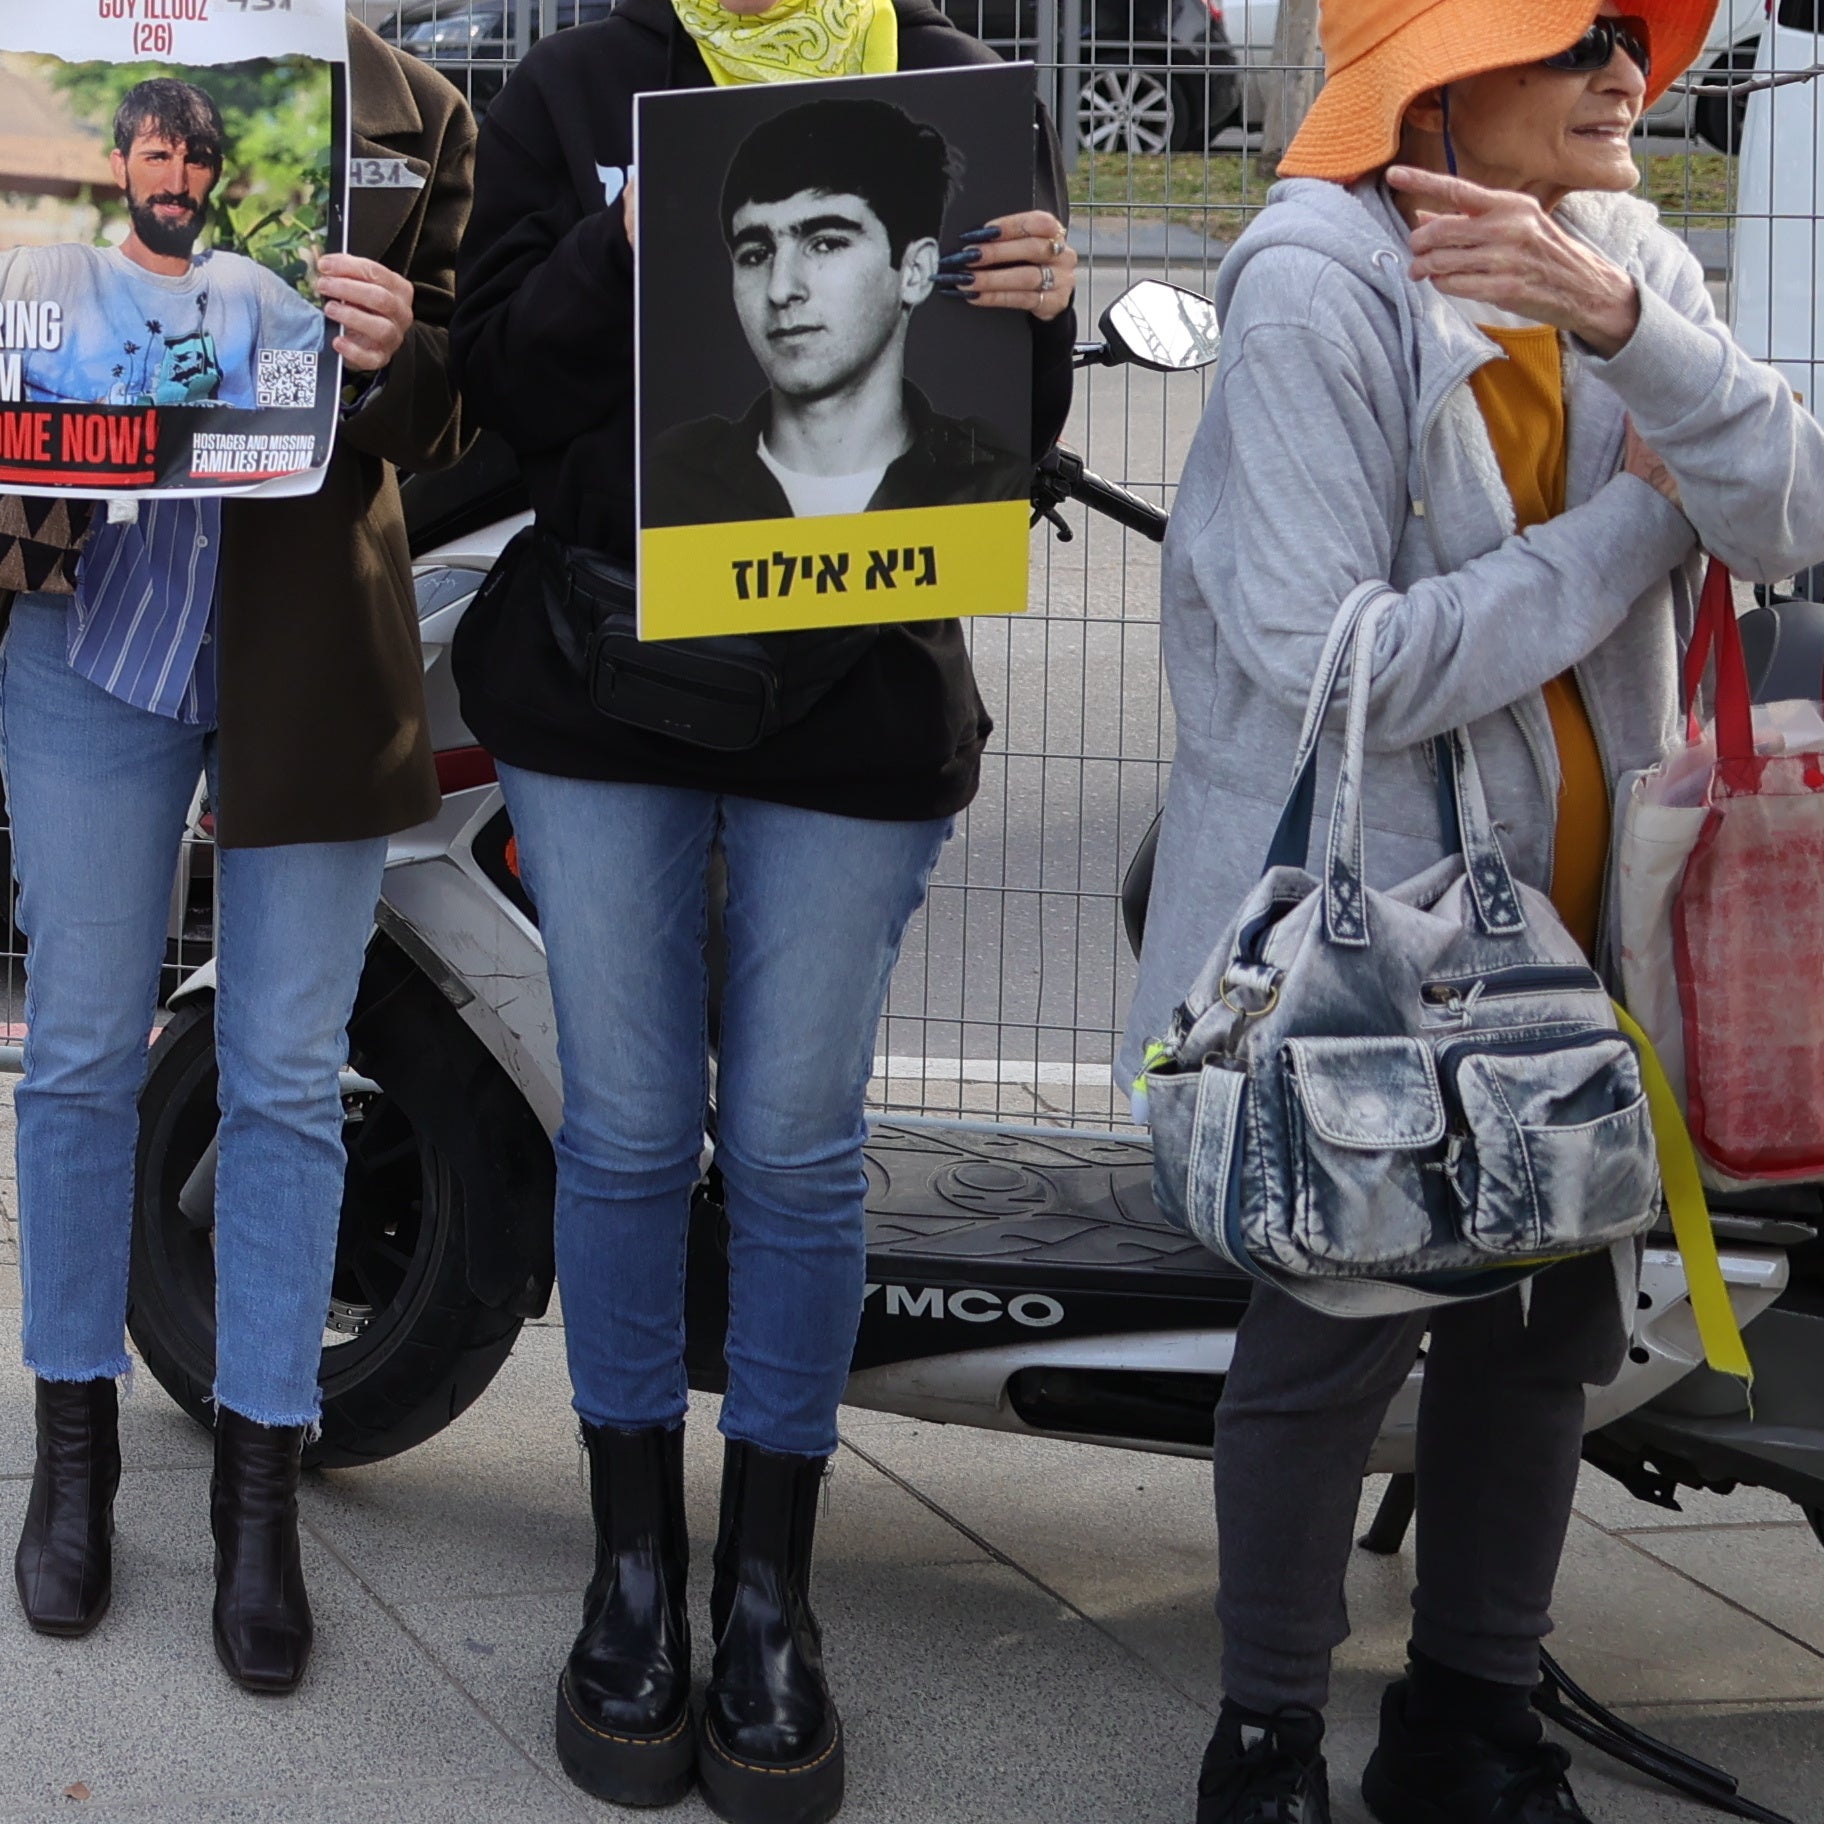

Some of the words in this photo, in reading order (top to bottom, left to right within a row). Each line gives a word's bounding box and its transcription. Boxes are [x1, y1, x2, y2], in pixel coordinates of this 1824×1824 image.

[133, 22, 173, 55] (26)
[61, 409, 158, 464] NOW!
[192, 433, 246, 450] HOSTAGES
[247, 435, 268, 450] AND
[269, 435, 315, 450] MISSING
[191, 450, 257, 473] FAMILIES
[259, 451, 313, 472] FORUM
[732, 551, 850, 600] אילוז
[865, 545, 937, 591] גיא
